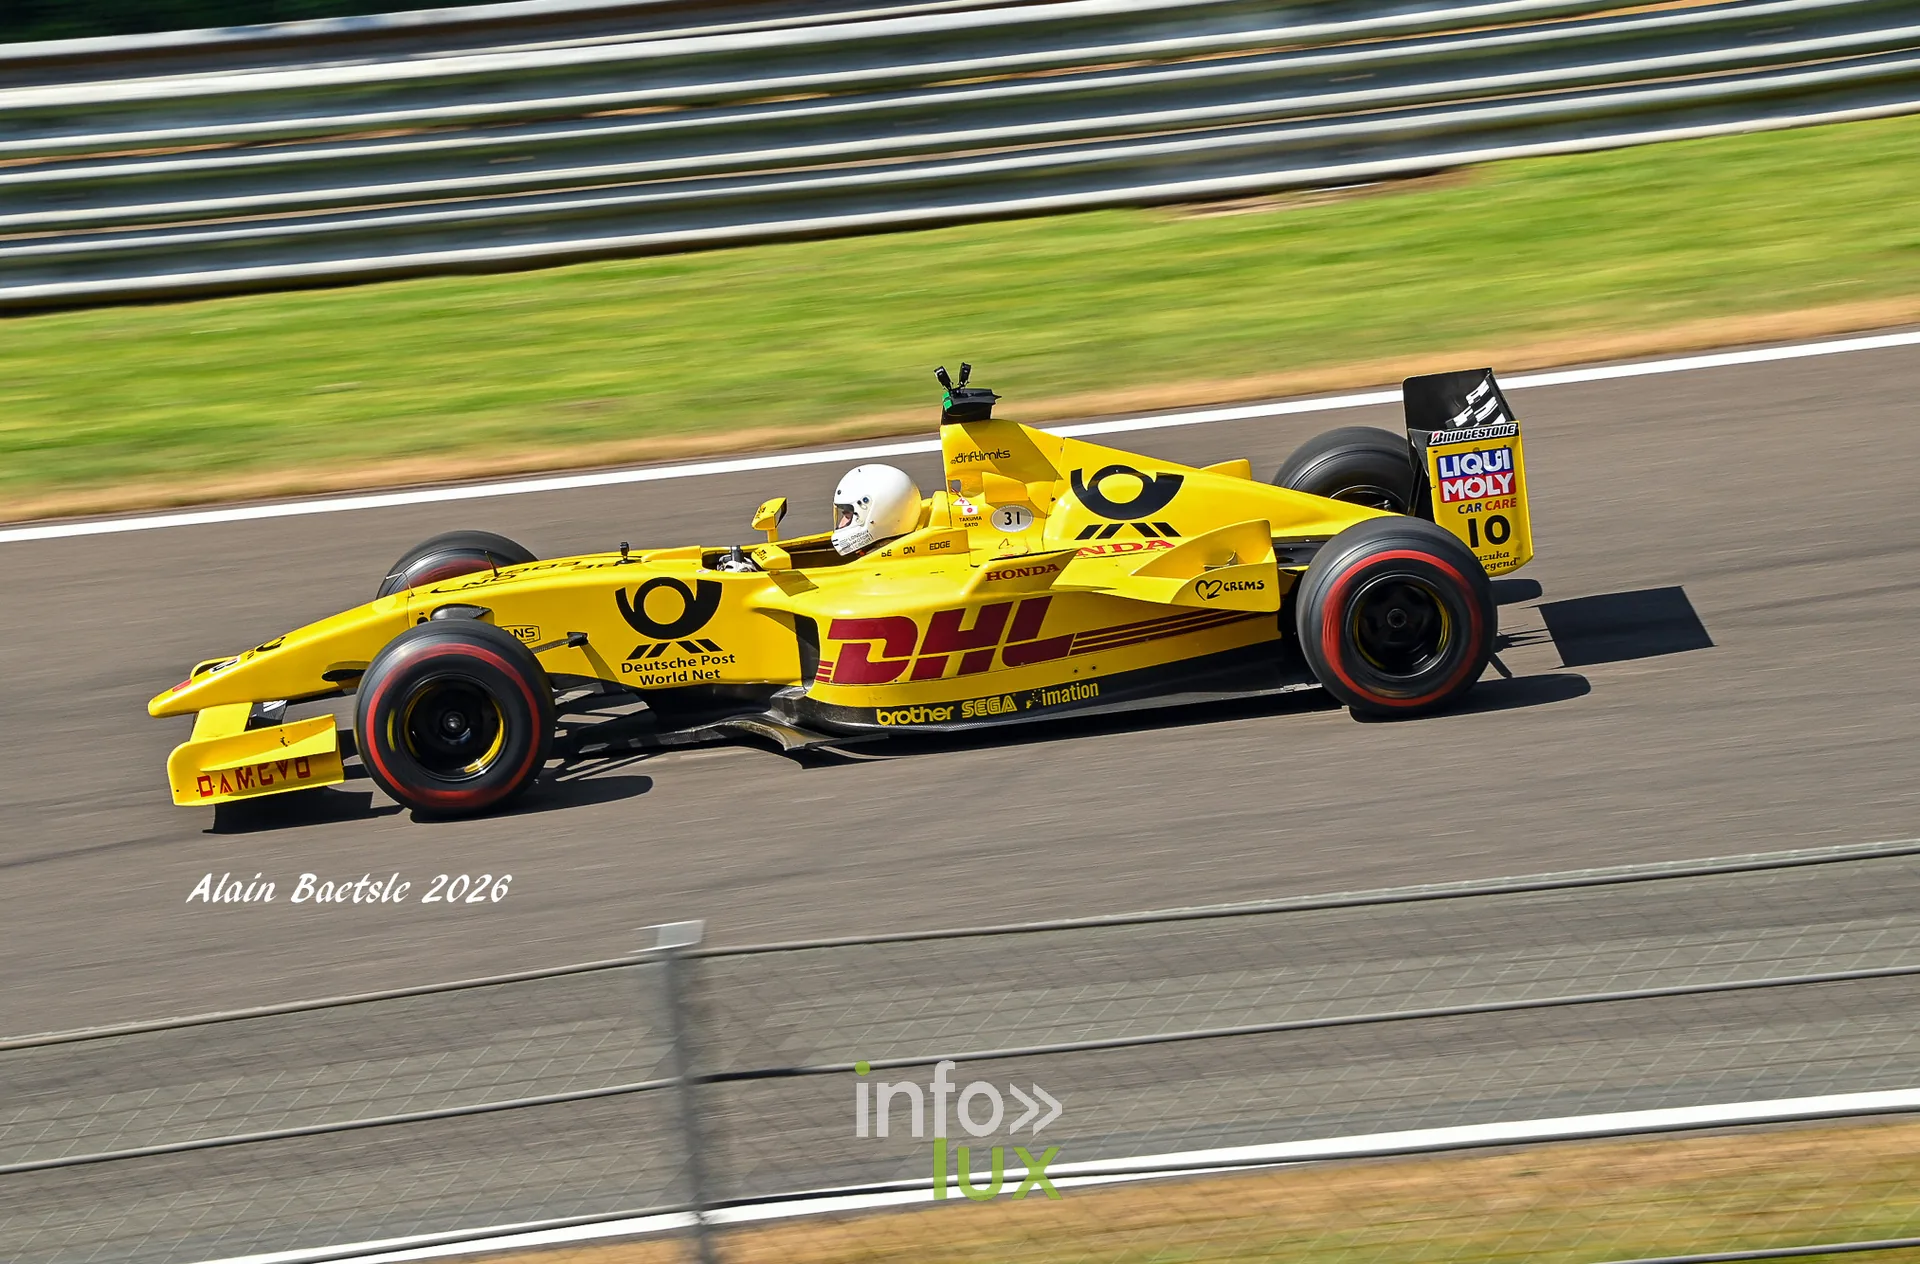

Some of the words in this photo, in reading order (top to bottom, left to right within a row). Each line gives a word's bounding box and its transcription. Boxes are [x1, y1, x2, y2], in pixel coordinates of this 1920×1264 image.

[1429, 423, 1517, 446] BRIDGESTONE
[1438, 448, 1512, 478] LIQUI
[1441, 472, 1514, 502] MOLY
[1457, 503, 1482, 514] CAR
[1485, 497, 1517, 511] CARE
[1004, 511, 1020, 525] 31
[1467, 514, 1511, 549] 10
[903, 546, 916, 555] ON
[929, 540, 951, 551] EDGE
[1076, 539, 1176, 557] NDA
[1475, 550, 1511, 562] uzuka
[985, 563, 1061, 582] HONDA
[1223, 579, 1265, 592] CREMS
[827, 595, 1076, 684] DHL
[621, 657, 697, 674] Deutsche
[701, 653, 736, 666] Post
[639, 670, 688, 686] World
[693, 668, 721, 681] Net
[875, 705, 954, 727] brother
[961, 695, 1018, 719] SEGA
[1041, 682, 1100, 707] imation
